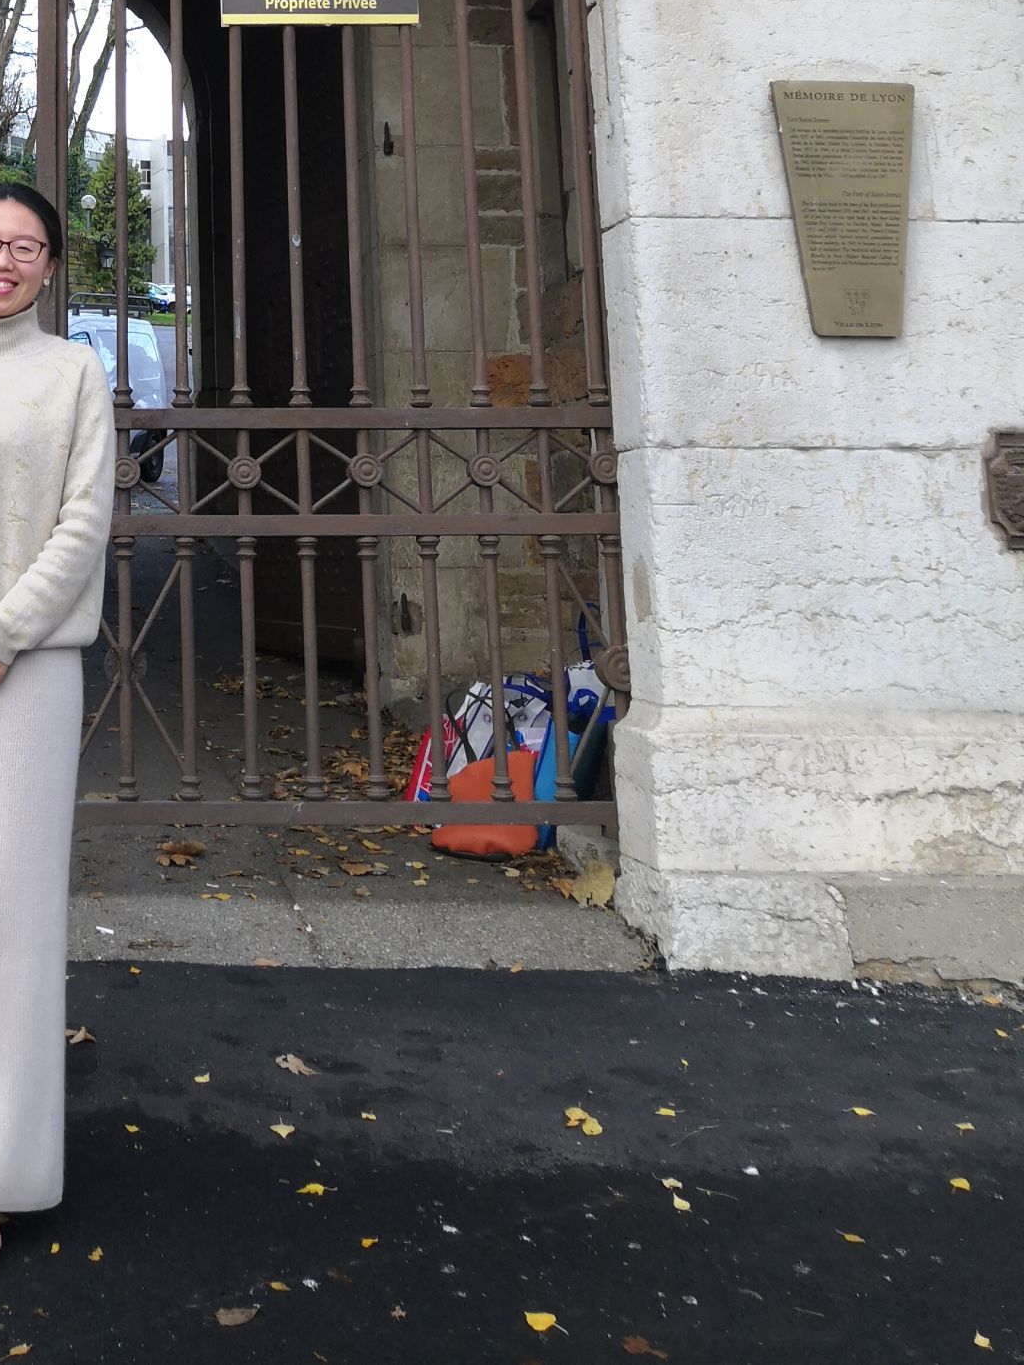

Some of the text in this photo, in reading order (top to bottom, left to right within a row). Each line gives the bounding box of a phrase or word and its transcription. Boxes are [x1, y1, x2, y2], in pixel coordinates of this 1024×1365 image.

[783, 89, 906, 104] MÉMOIRE DE LYON
